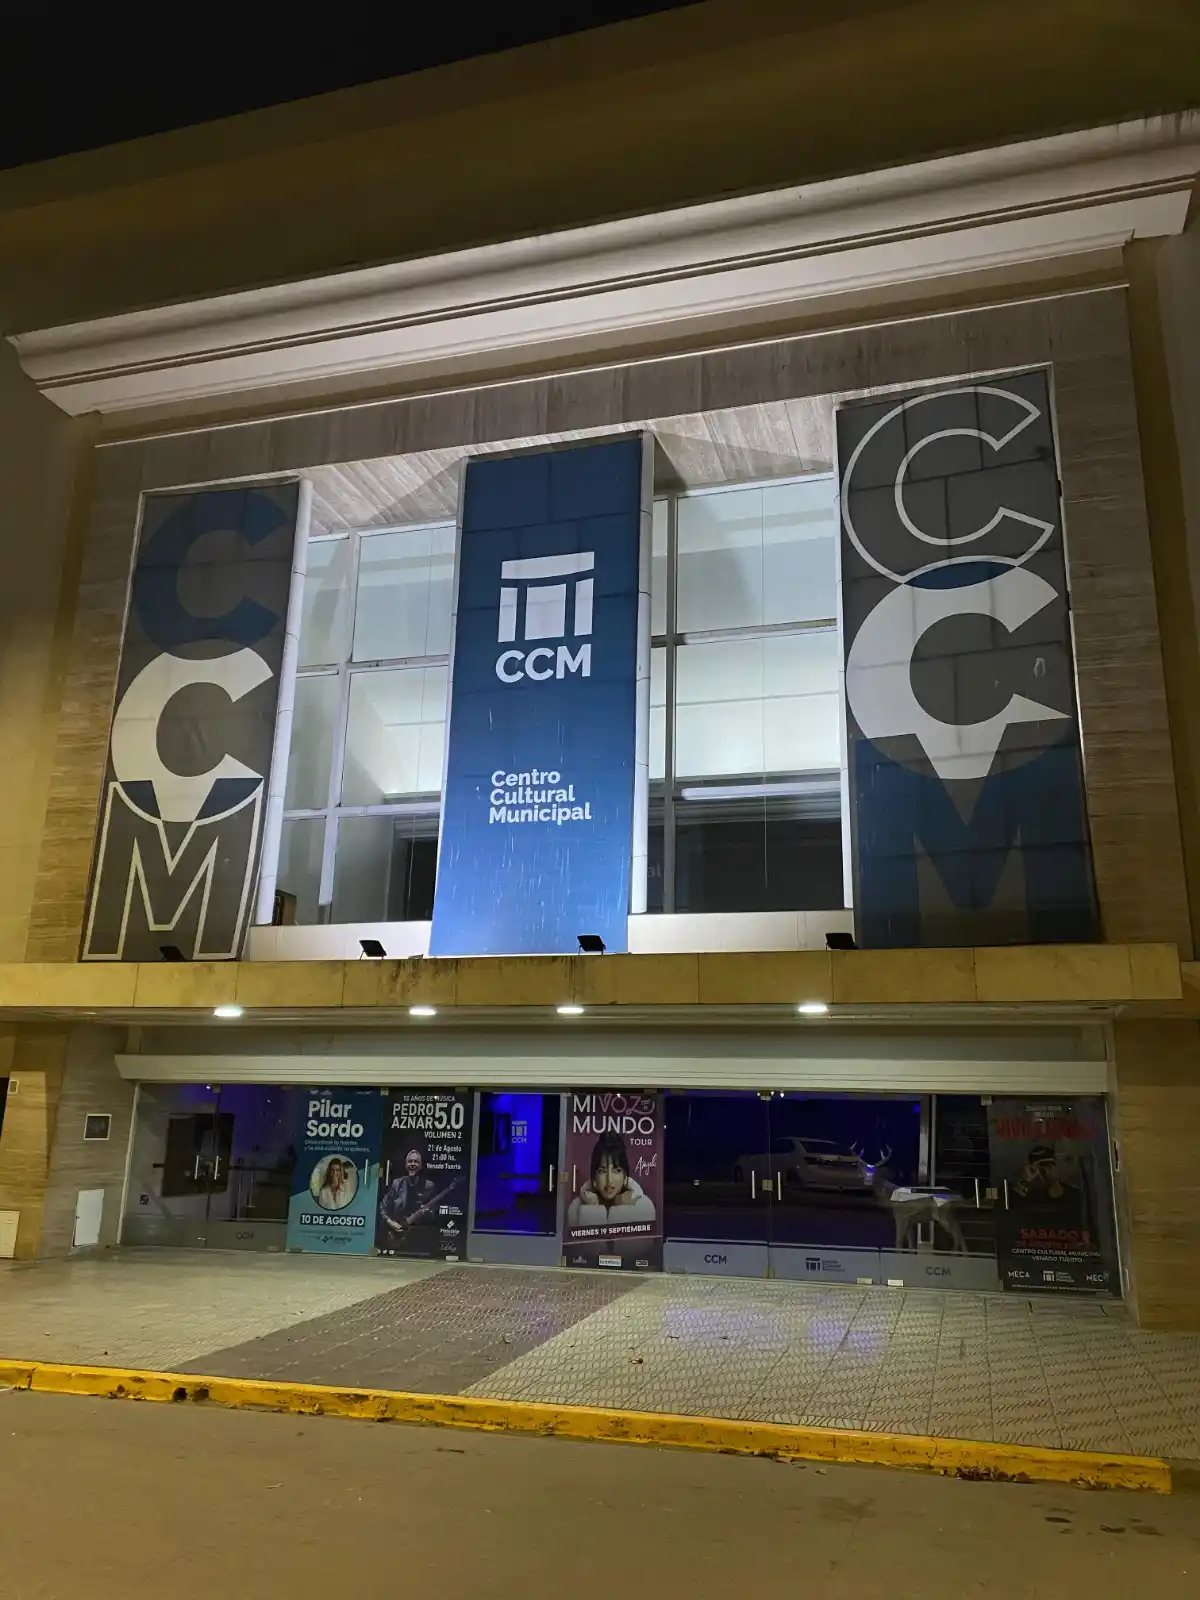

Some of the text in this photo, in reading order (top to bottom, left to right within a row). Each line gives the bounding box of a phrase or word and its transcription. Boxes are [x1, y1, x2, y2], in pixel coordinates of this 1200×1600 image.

[495, 643, 592, 683] CCM
[491, 768, 561, 787] Centro
[490, 784, 576, 806] Cultural
[489, 801, 592, 826] Municipal
[307, 1098, 353, 1118] Pilar
[392, 1102, 434, 1116] PEDRO
[573, 1094, 596, 1113] MI
[390, 1116, 434, 1129] AZNAR
[433, 1102, 465, 1130] 5.0
[573, 1115, 655, 1135] MUNDO
[306, 1119, 364, 1138] Sordo
[424, 1131, 462, 1139] VOLUMEN 2
[427, 1144, 435, 1152] 21
[443, 1144, 462, 1154] Agosto
[629, 1138, 653, 1146] TOUR
[301, 1214, 365, 1226] 10 DE AGOSTO
[570, 1224, 652, 1237] VIERNES 19 SEPTIEMBRE
[704, 1254, 728, 1265] CCM
